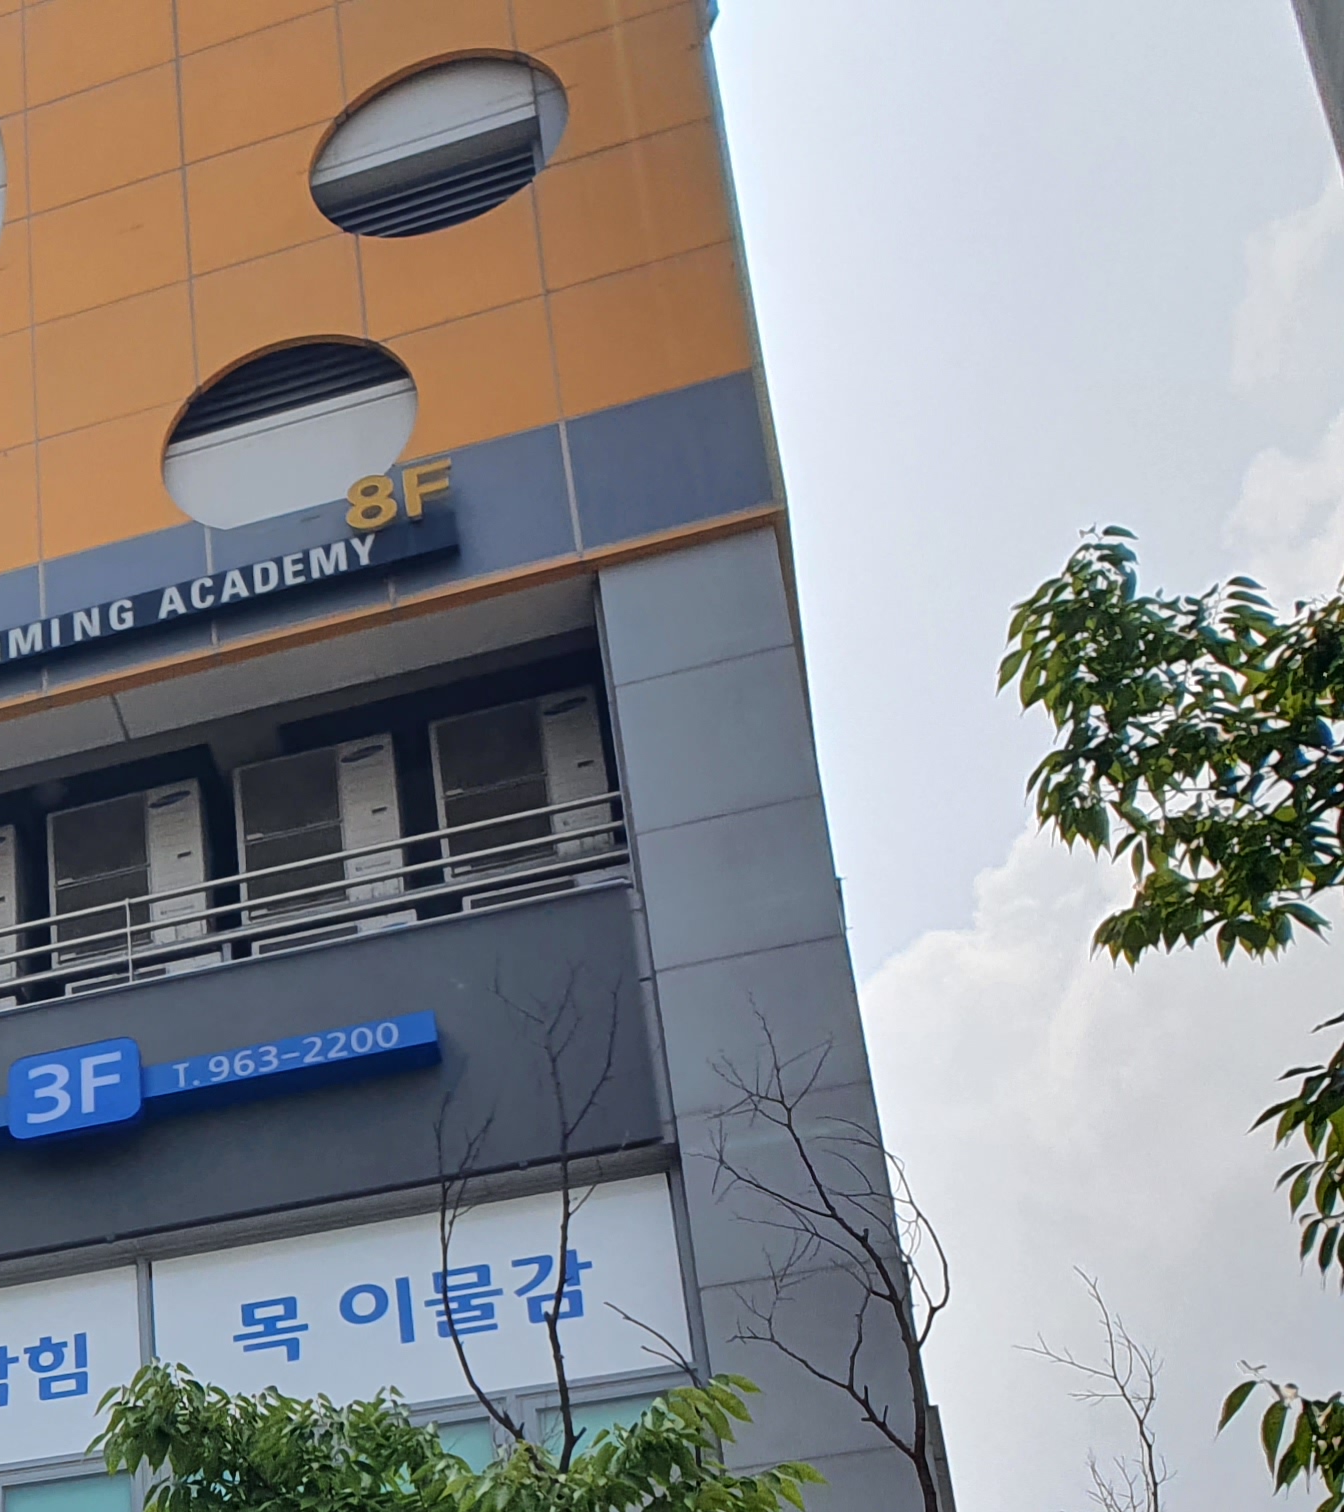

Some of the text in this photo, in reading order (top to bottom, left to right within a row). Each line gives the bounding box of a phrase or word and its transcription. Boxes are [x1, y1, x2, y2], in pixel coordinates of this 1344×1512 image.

[346, 458, 453, 532] 8F
[157, 534, 377, 620] ACADEMY
[24, 1050, 123, 1126] 3F
[231, 1294, 311, 1364] 목
[337, 1247, 596, 1346] 이물감
